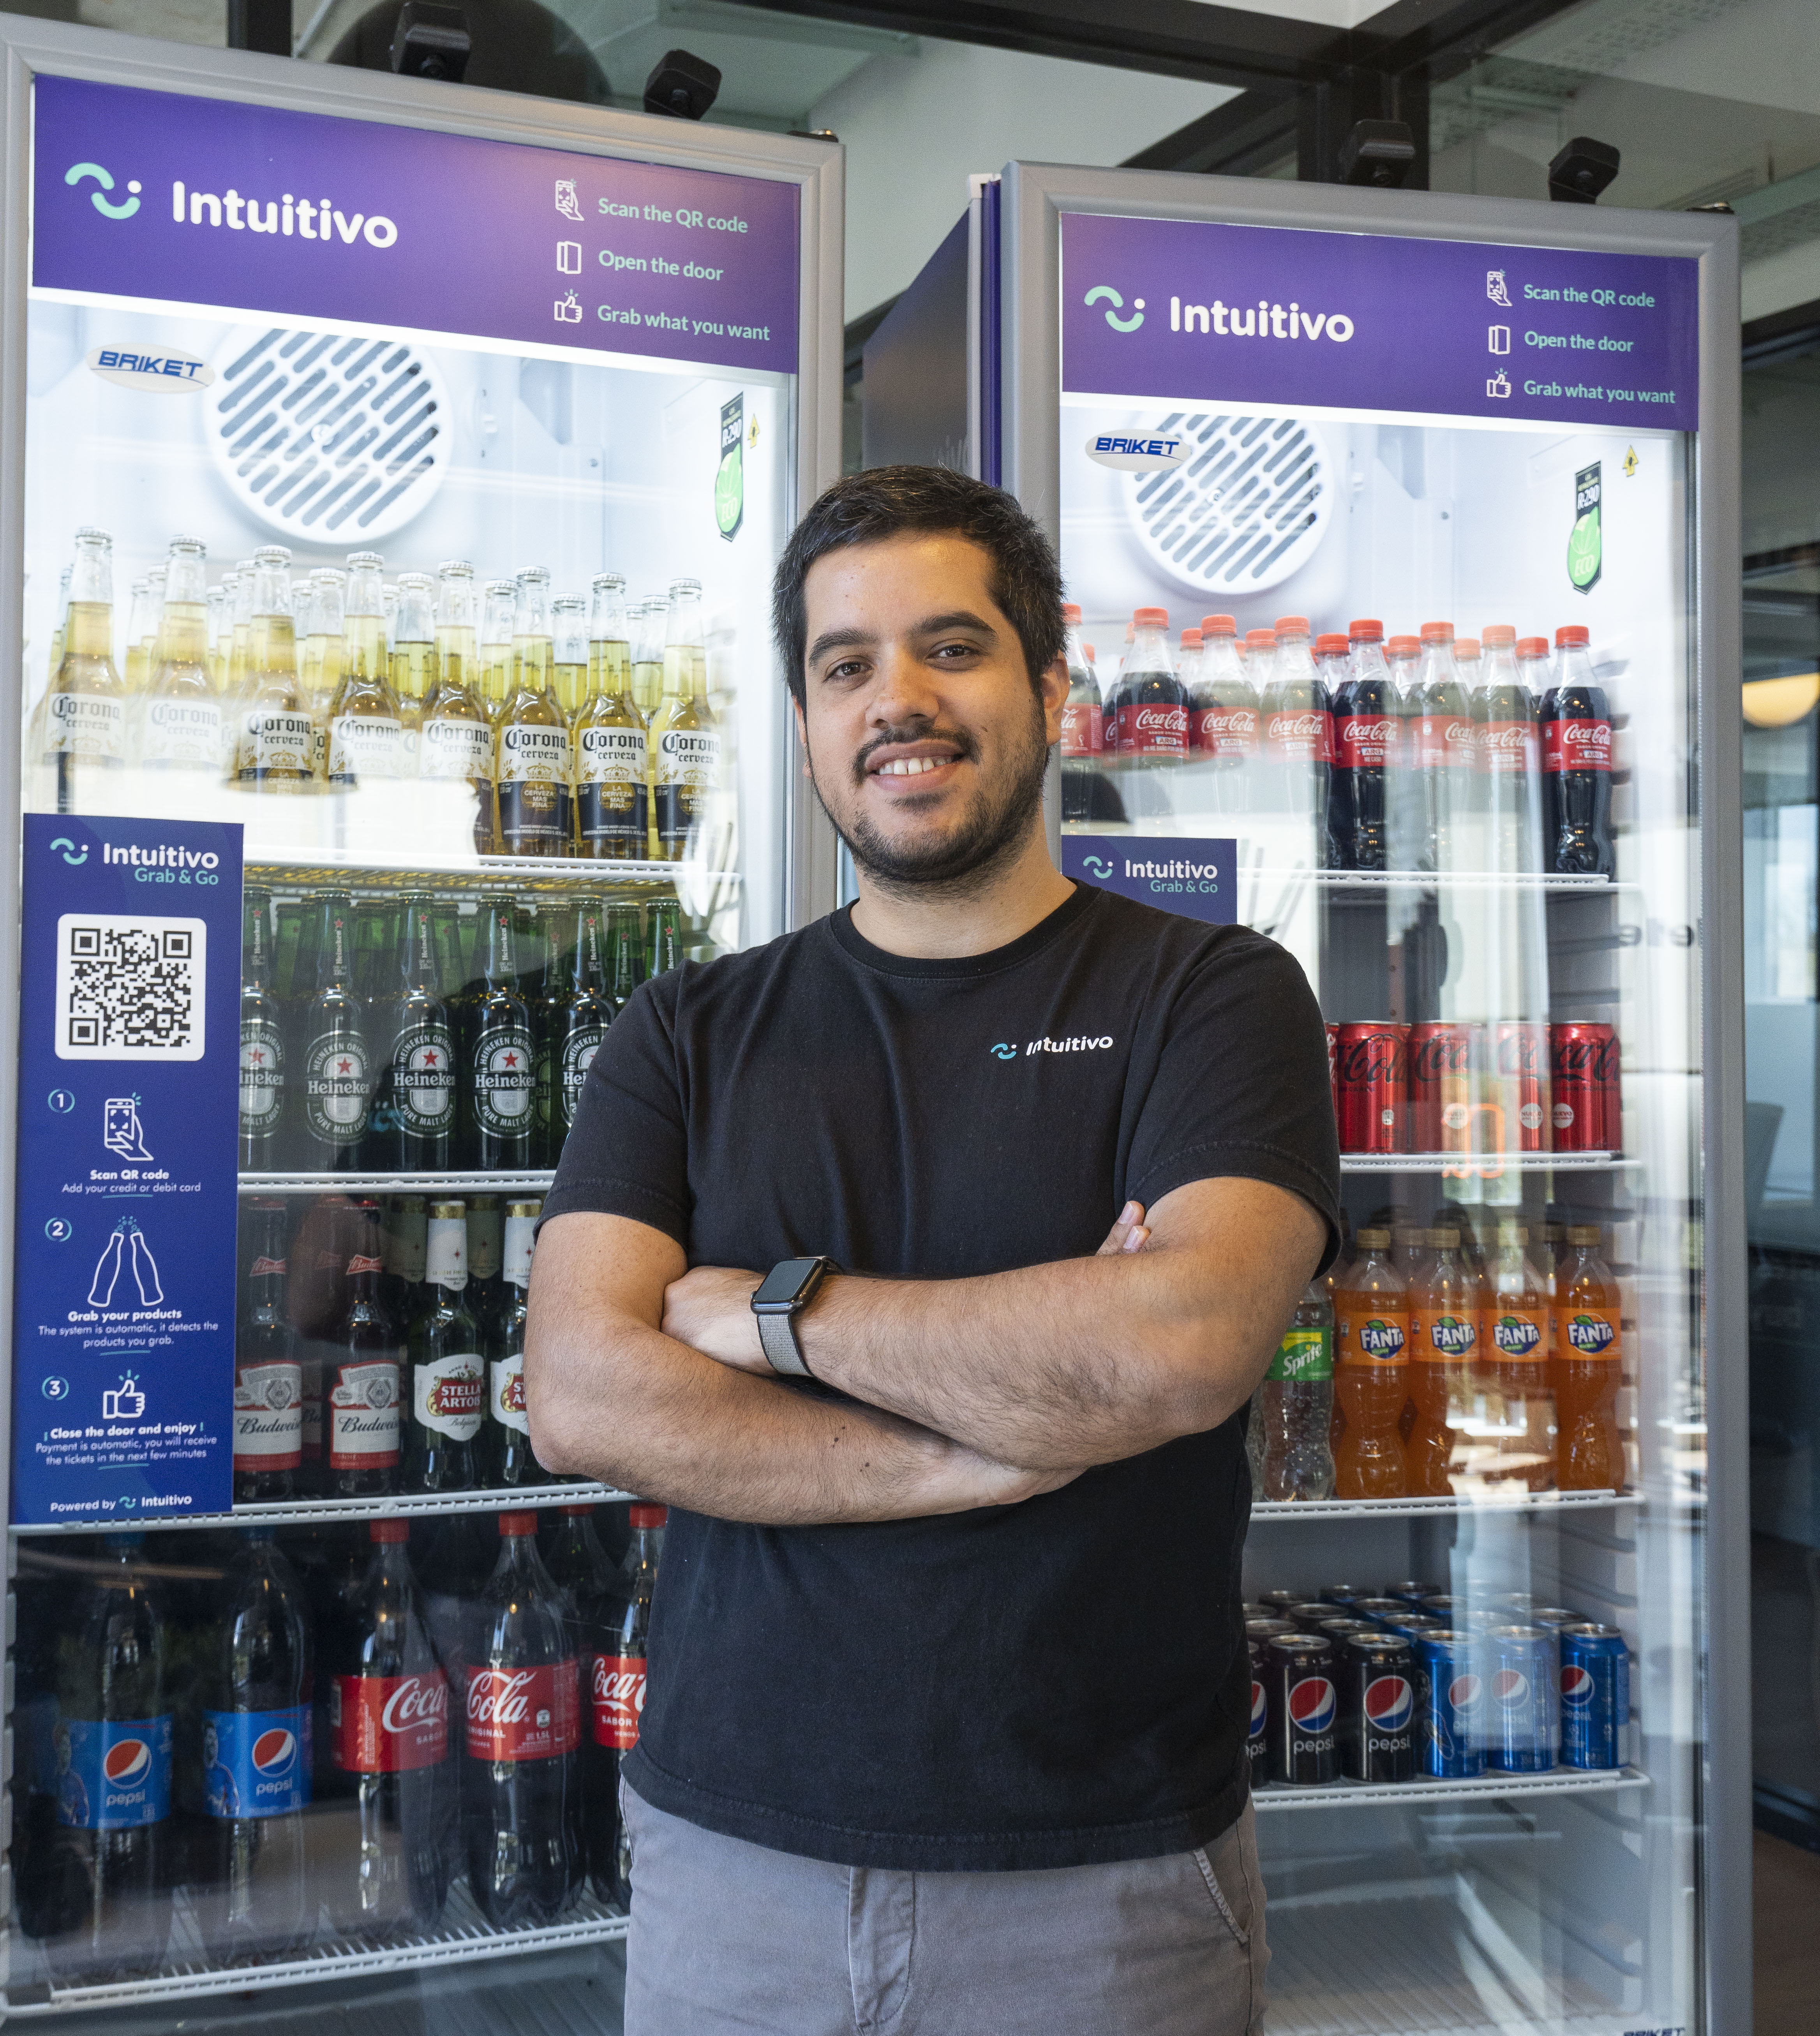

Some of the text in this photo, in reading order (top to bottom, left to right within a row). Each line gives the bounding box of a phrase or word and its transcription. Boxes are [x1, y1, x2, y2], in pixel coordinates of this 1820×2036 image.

[173, 181, 398, 248] Intuitivo
[598, 197, 748, 233] Scan the QR code
[598, 250, 724, 281] Open the door
[1524, 284, 1655, 308] Scan the QR code
[597, 305, 771, 341] Grab what you want
[1170, 296, 1354, 342] Intuitivo
[1524, 331, 1634, 352] Open the door
[98, 351, 205, 379] BRIKET
[1524, 380, 1675, 404] Grab what you want
[1095, 437, 1180, 456] BRIKET
[1577, 484, 1600, 510] R-290
[721, 497, 738, 523] ECO
[1574, 554, 1595, 577] ECO
[52, 696, 120, 720] Corona
[151, 702, 218, 728] Corona
[247, 712, 310, 736] Corona
[337, 719, 399, 743] Corona
[1136, 709, 1187, 731] Coca-Cola
[1201, 711, 1256, 733] Coca-Cola
[1269, 714, 1324, 738] Coca-Cola
[264, 734, 304, 746] cerveza
[428, 722, 490, 745] Corona
[506, 729, 566, 752] Corona
[583, 731, 644, 753] Corona
[1344, 721, 1398, 742] Coca-Cola
[1563, 724, 1611, 746] Coca-Cola
[443, 742, 482, 755] cerveza
[521, 750, 559, 760] cerveza
[663, 733, 720, 756] Corona
[598, 751, 637, 761] cerveza
[678, 754, 714, 764] cerveza
[104, 843, 219, 869] Intuitivo
[134, 867, 219, 885] Grab & Go
[1125, 859, 1218, 879] Intuitivo
[1150, 880, 1218, 893] Grab & Go
[589, 927, 597, 961] Heineken
[312, 1043, 344, 1071] HEINEKEN
[399, 1035, 430, 1063] HEINEKEN
[480, 1037, 510, 1065] HEINEKEN
[568, 1035, 598, 1063] HEINEKEN
[1026, 1036, 1113, 1056] Intuitivo
[57, 1093, 63, 1108] 1
[314, 1111, 331, 1130] PURE
[333, 1124, 353, 1134] MALT
[401, 1103, 418, 1123] PURE
[419, 1117, 439, 1126] MALT
[481, 1105, 519, 1127] PURE MALT
[90, 1169, 169, 1181] Scan QR code
[61, 1183, 83, 1193] Add
[85, 1185, 108, 1195] your
[109, 1183, 138, 1192] credit
[152, 1182, 177, 1192] debit
[179, 1182, 201, 1192] card
[52, 1222, 63, 1236] 2
[68, 1309, 182, 1323] Grab your products
[39, 1322, 219, 1337] The system is automatic, it detects the
[1361, 1326, 1404, 1349] FANTA
[1432, 1324, 1475, 1345] FANTA
[1494, 1324, 1540, 1345] FANTA
[1567, 1323, 1614, 1343] FANTA
[83, 1336, 174, 1349] products you grab.
[1283, 1344, 1323, 1377] Sprite
[49, 1380, 61, 1396] 3
[50, 1422, 197, 1440] Close the door and enjoy
[35, 1436, 217, 1454] Payment is automatic, you will receive
[46, 1449, 207, 1466] the tickets in the next few minutes
[50, 1495, 192, 1512] Powered by Intuitivo
[601, 1715, 632, 1727] SABOR
[1293, 1735, 1335, 1754] pepsi
[1369, 1735, 1411, 1754] pepsi
[106, 1790, 146, 1806] pepsi
[256, 1778, 293, 1796] pepsi
